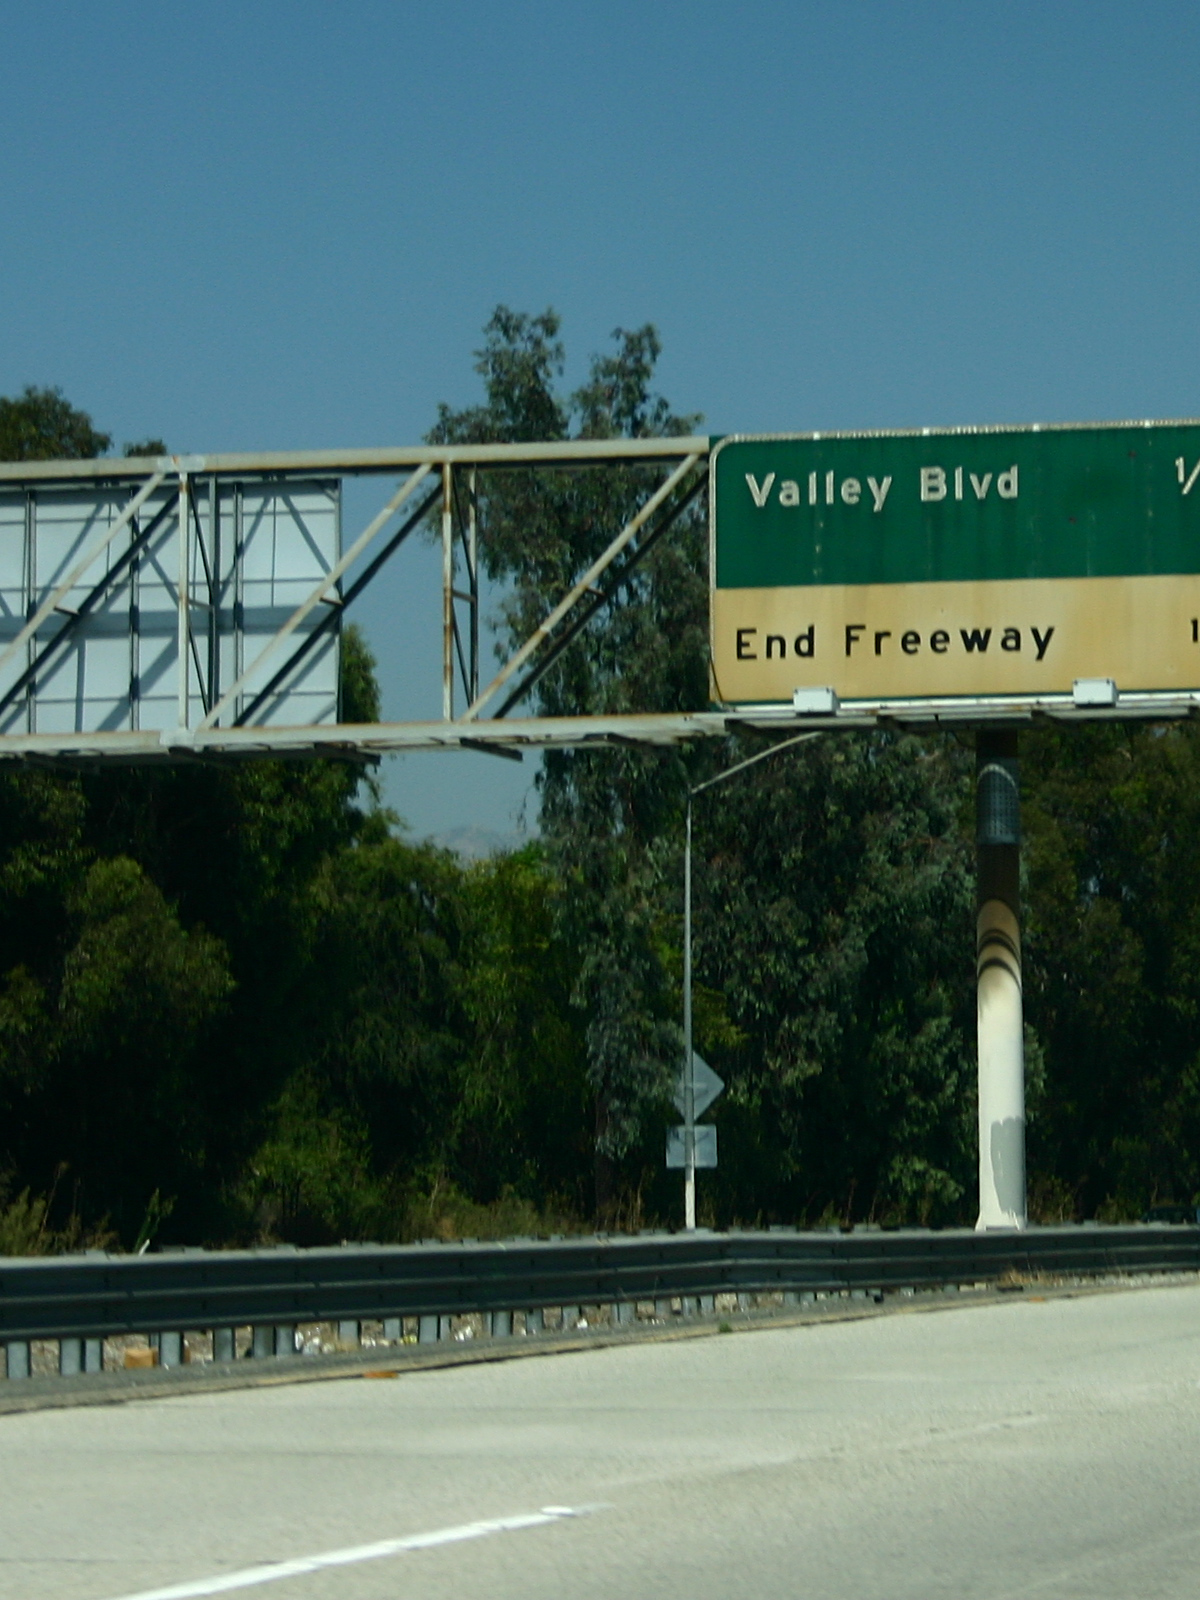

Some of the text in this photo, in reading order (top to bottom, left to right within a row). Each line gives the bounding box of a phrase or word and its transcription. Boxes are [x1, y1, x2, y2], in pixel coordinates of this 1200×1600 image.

[745, 470, 893, 513] Valley
[920, 463, 1019, 502] Blvd
[736, 624, 815, 661] End
[845, 623, 1055, 662] Freeway
